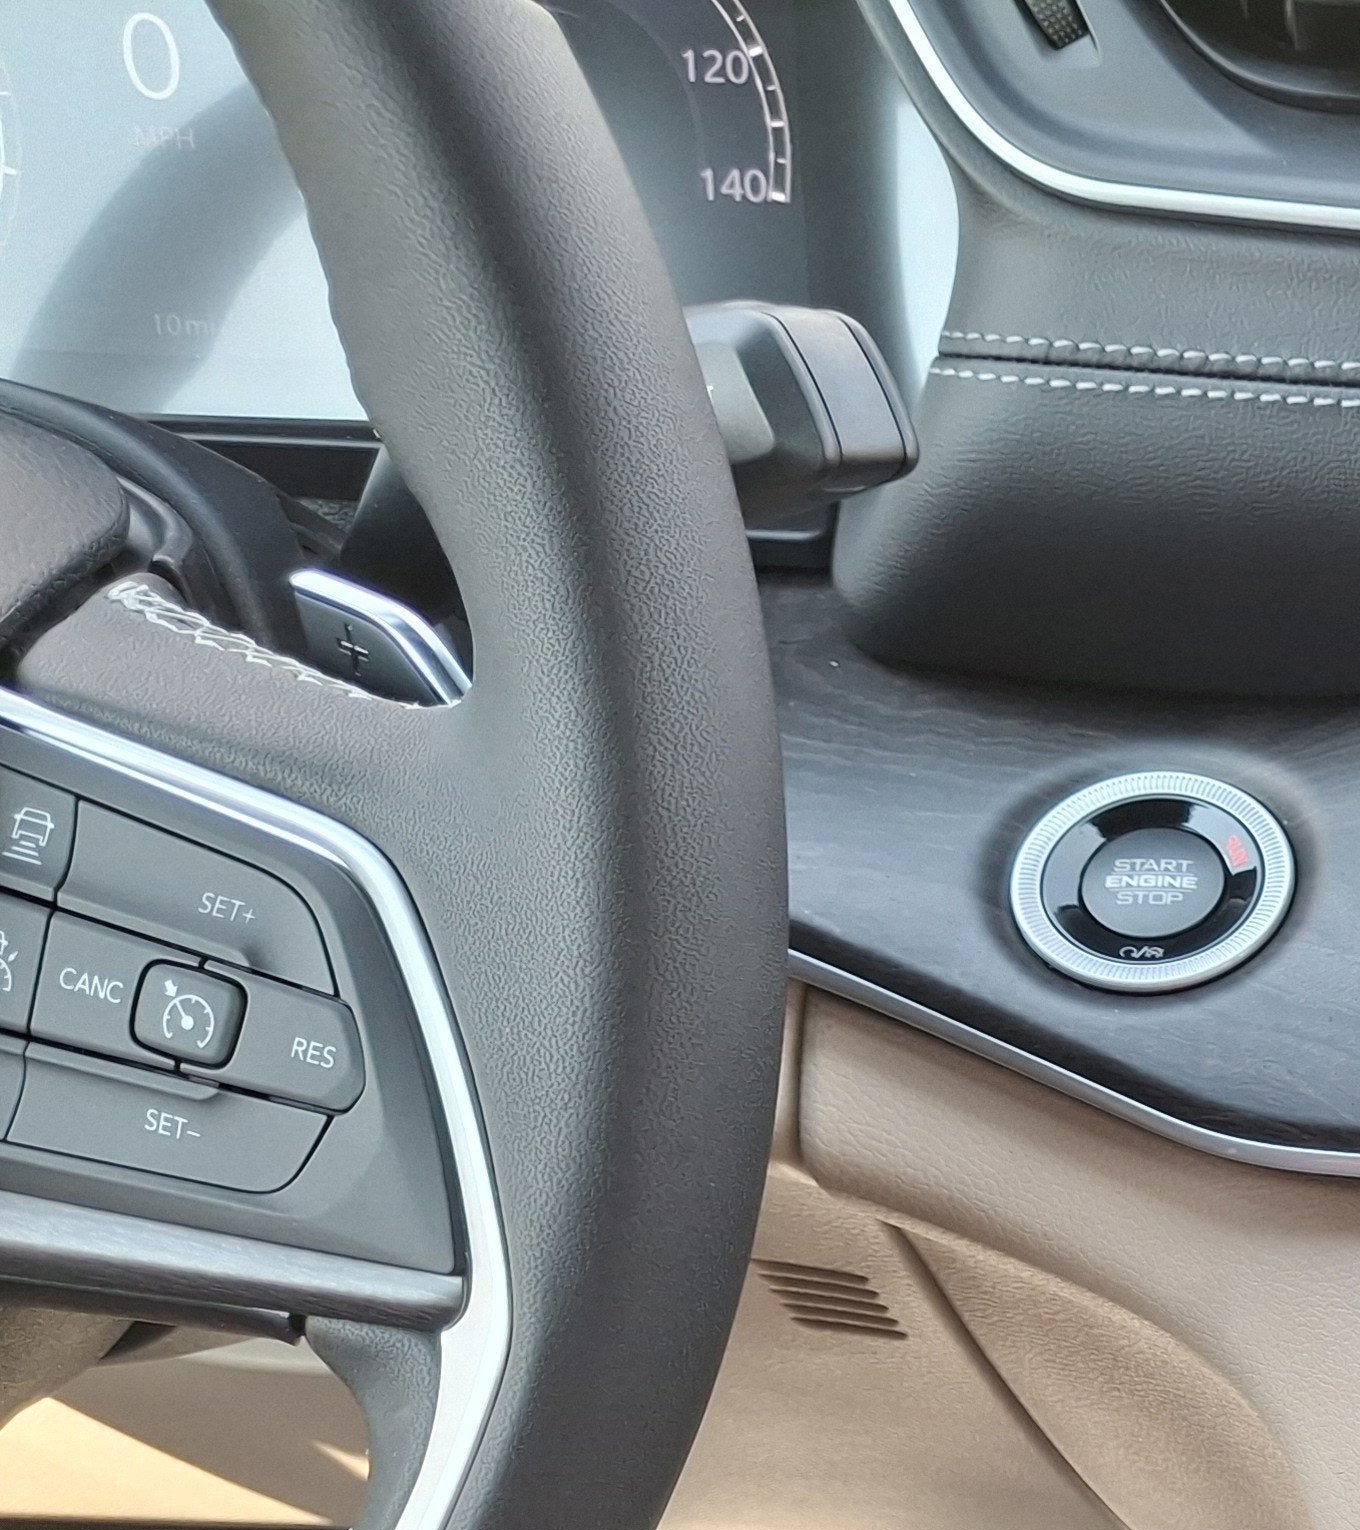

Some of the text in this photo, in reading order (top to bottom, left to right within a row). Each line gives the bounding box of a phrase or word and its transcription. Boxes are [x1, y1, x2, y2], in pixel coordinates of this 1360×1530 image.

[123, 13, 180, 100] 0
[682, 49, 750, 85] 120
[700, 168, 767, 203] 140
[1114, 859, 1194, 872] START
[1105, 875, 1198, 889] ENGINE
[199, 892, 256, 923] SET+
[1116, 891, 1183, 905] STOP
[60, 967, 124, 1005] CANC
[291, 1037, 336, 1068] RES
[144, 1109, 200, 1139] SET-
